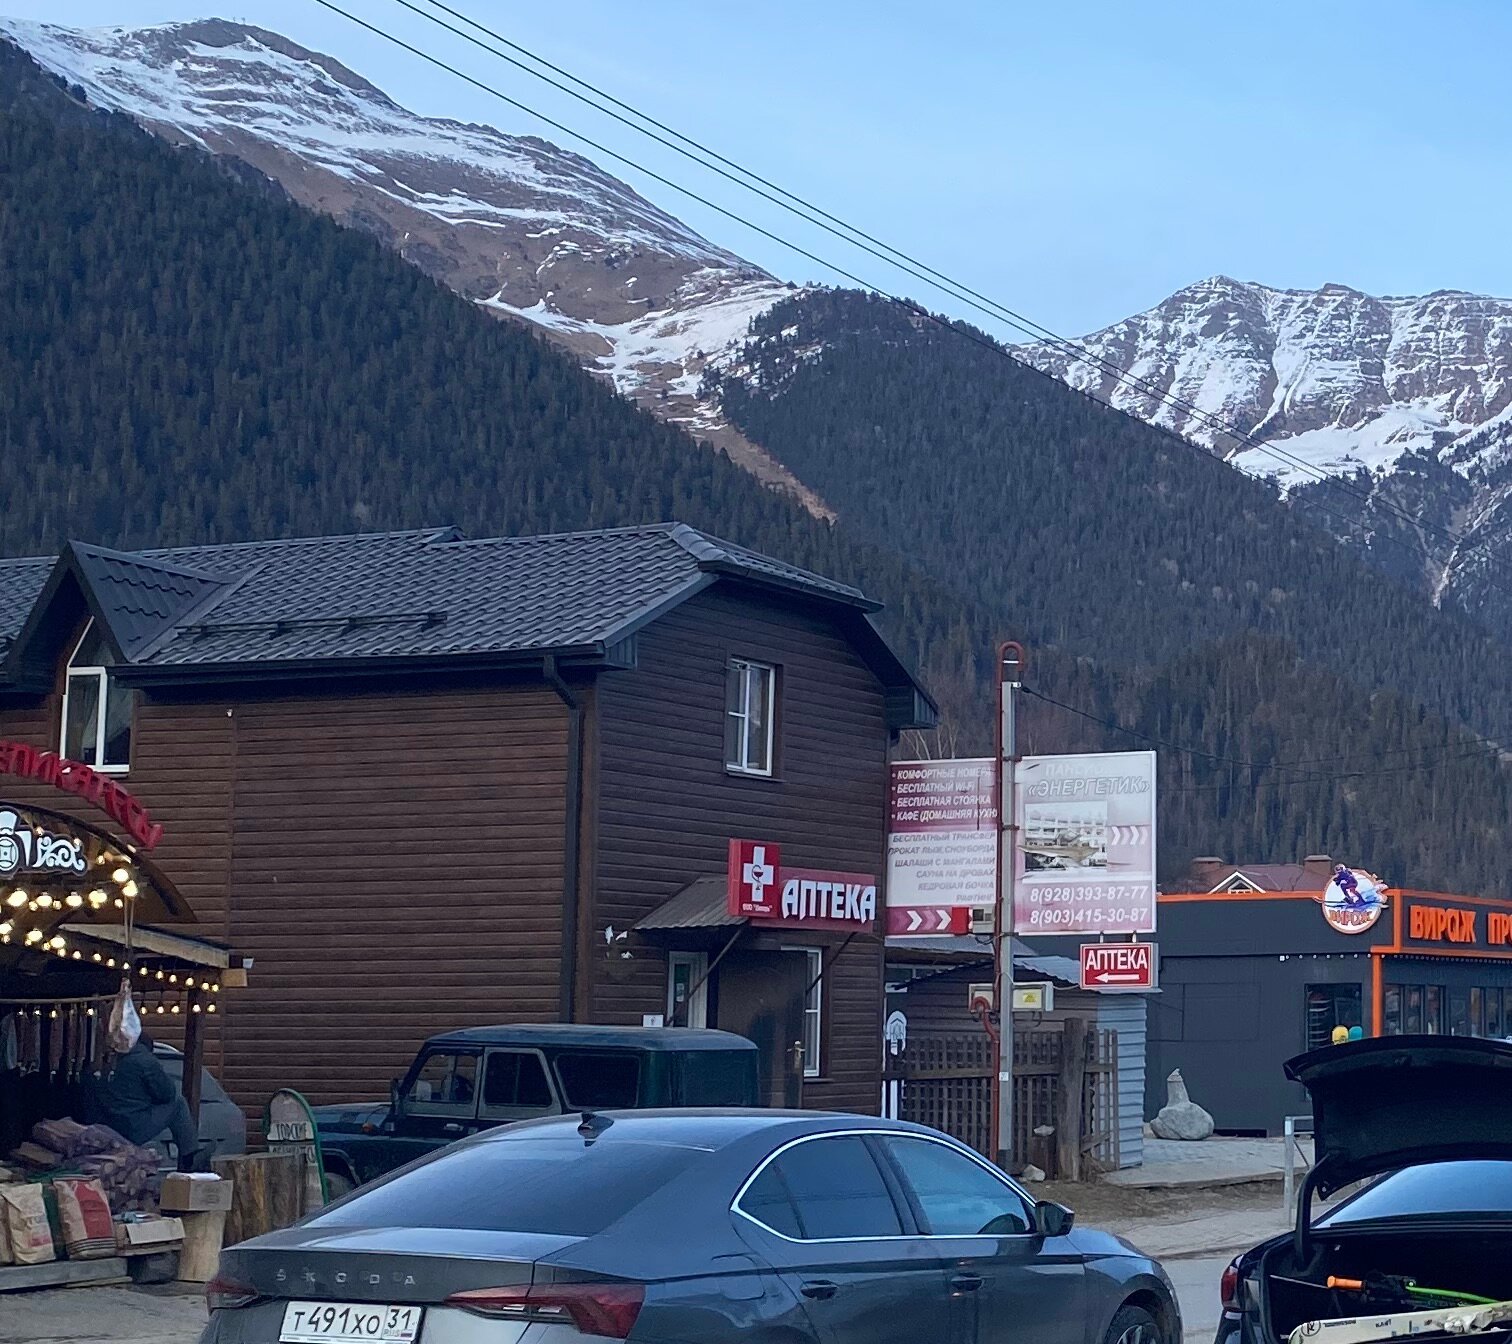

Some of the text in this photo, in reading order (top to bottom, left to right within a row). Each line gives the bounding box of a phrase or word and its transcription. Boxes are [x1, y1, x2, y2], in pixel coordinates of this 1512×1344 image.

[896, 769, 955, 780] КОМФОРТНЫЕ
[0, 740, 165, 851] ЕЛИКАТЕСЫ
[896, 781, 954, 794] БЕСПЛАТНЫЙ
[1028, 776, 1150, 797] «ЭНЕРГЕТИК»
[896, 796, 991, 808] БЕСПЛАТНАЯ СТОЯНКА
[896, 811, 919, 821] КАФЕ
[892, 834, 950, 843] БЕСПЛАТНЫЙ
[782, 879, 876, 924] АПТЕКА
[1030, 885, 1148, 904] 8(928)393-87-77
[1030, 908, 1148, 927] 8(903)415-30-87
[1410, 905, 1476, 943] ВИРАЖ
[1085, 949, 1148, 970] АПТЕКА
[386, 1308, 413, 1329] 31
[383, 1329, 400, 1337] RUS
